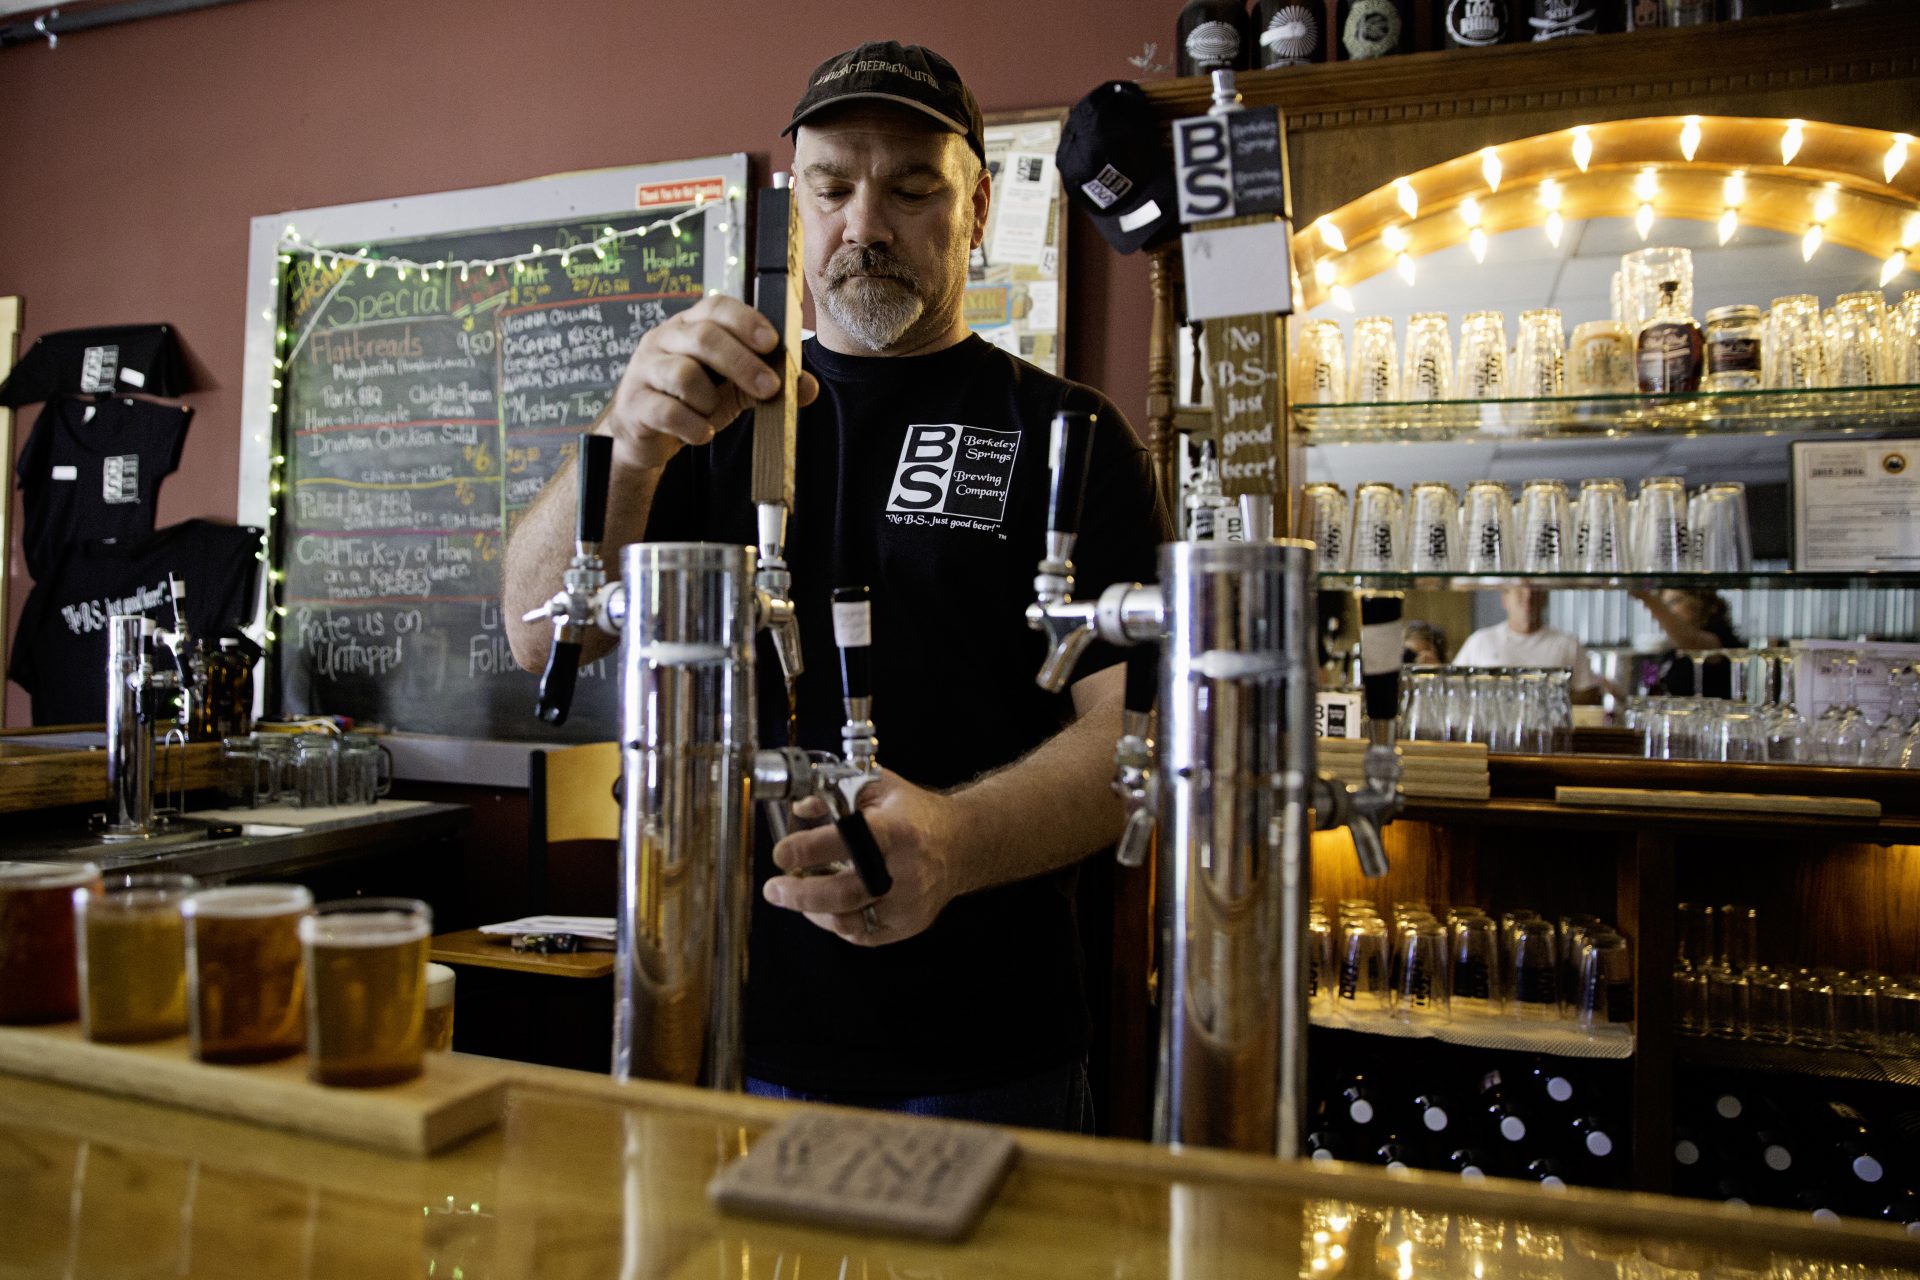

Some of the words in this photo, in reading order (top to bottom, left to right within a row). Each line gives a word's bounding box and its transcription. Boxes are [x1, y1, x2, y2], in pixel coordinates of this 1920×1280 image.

[1179, 120, 1227, 168] B
[1185, 166, 1230, 216] S
[642, 244, 700, 272] Howler
[327, 251, 452, 327] Special
[309, 324, 425, 366] Flatbreads
[1222, 325, 1261, 353] No
[1222, 393, 1264, 424] just
[375, 425, 436, 450] Chicken
[902, 425, 957, 464] B
[963, 435, 1017, 452] Berkeley
[1222, 423, 1274, 456] good
[965, 448, 1012, 464] Springs
[1220, 456, 1278, 481] beer!
[891, 463, 949, 510] S
[953, 470, 1003, 487] Brewing
[955, 484, 1006, 502] Company
[930, 516, 949, 527] just
[950, 519, 972, 529] good
[357, 611, 385, 637] us
[394, 609, 422, 635] on
